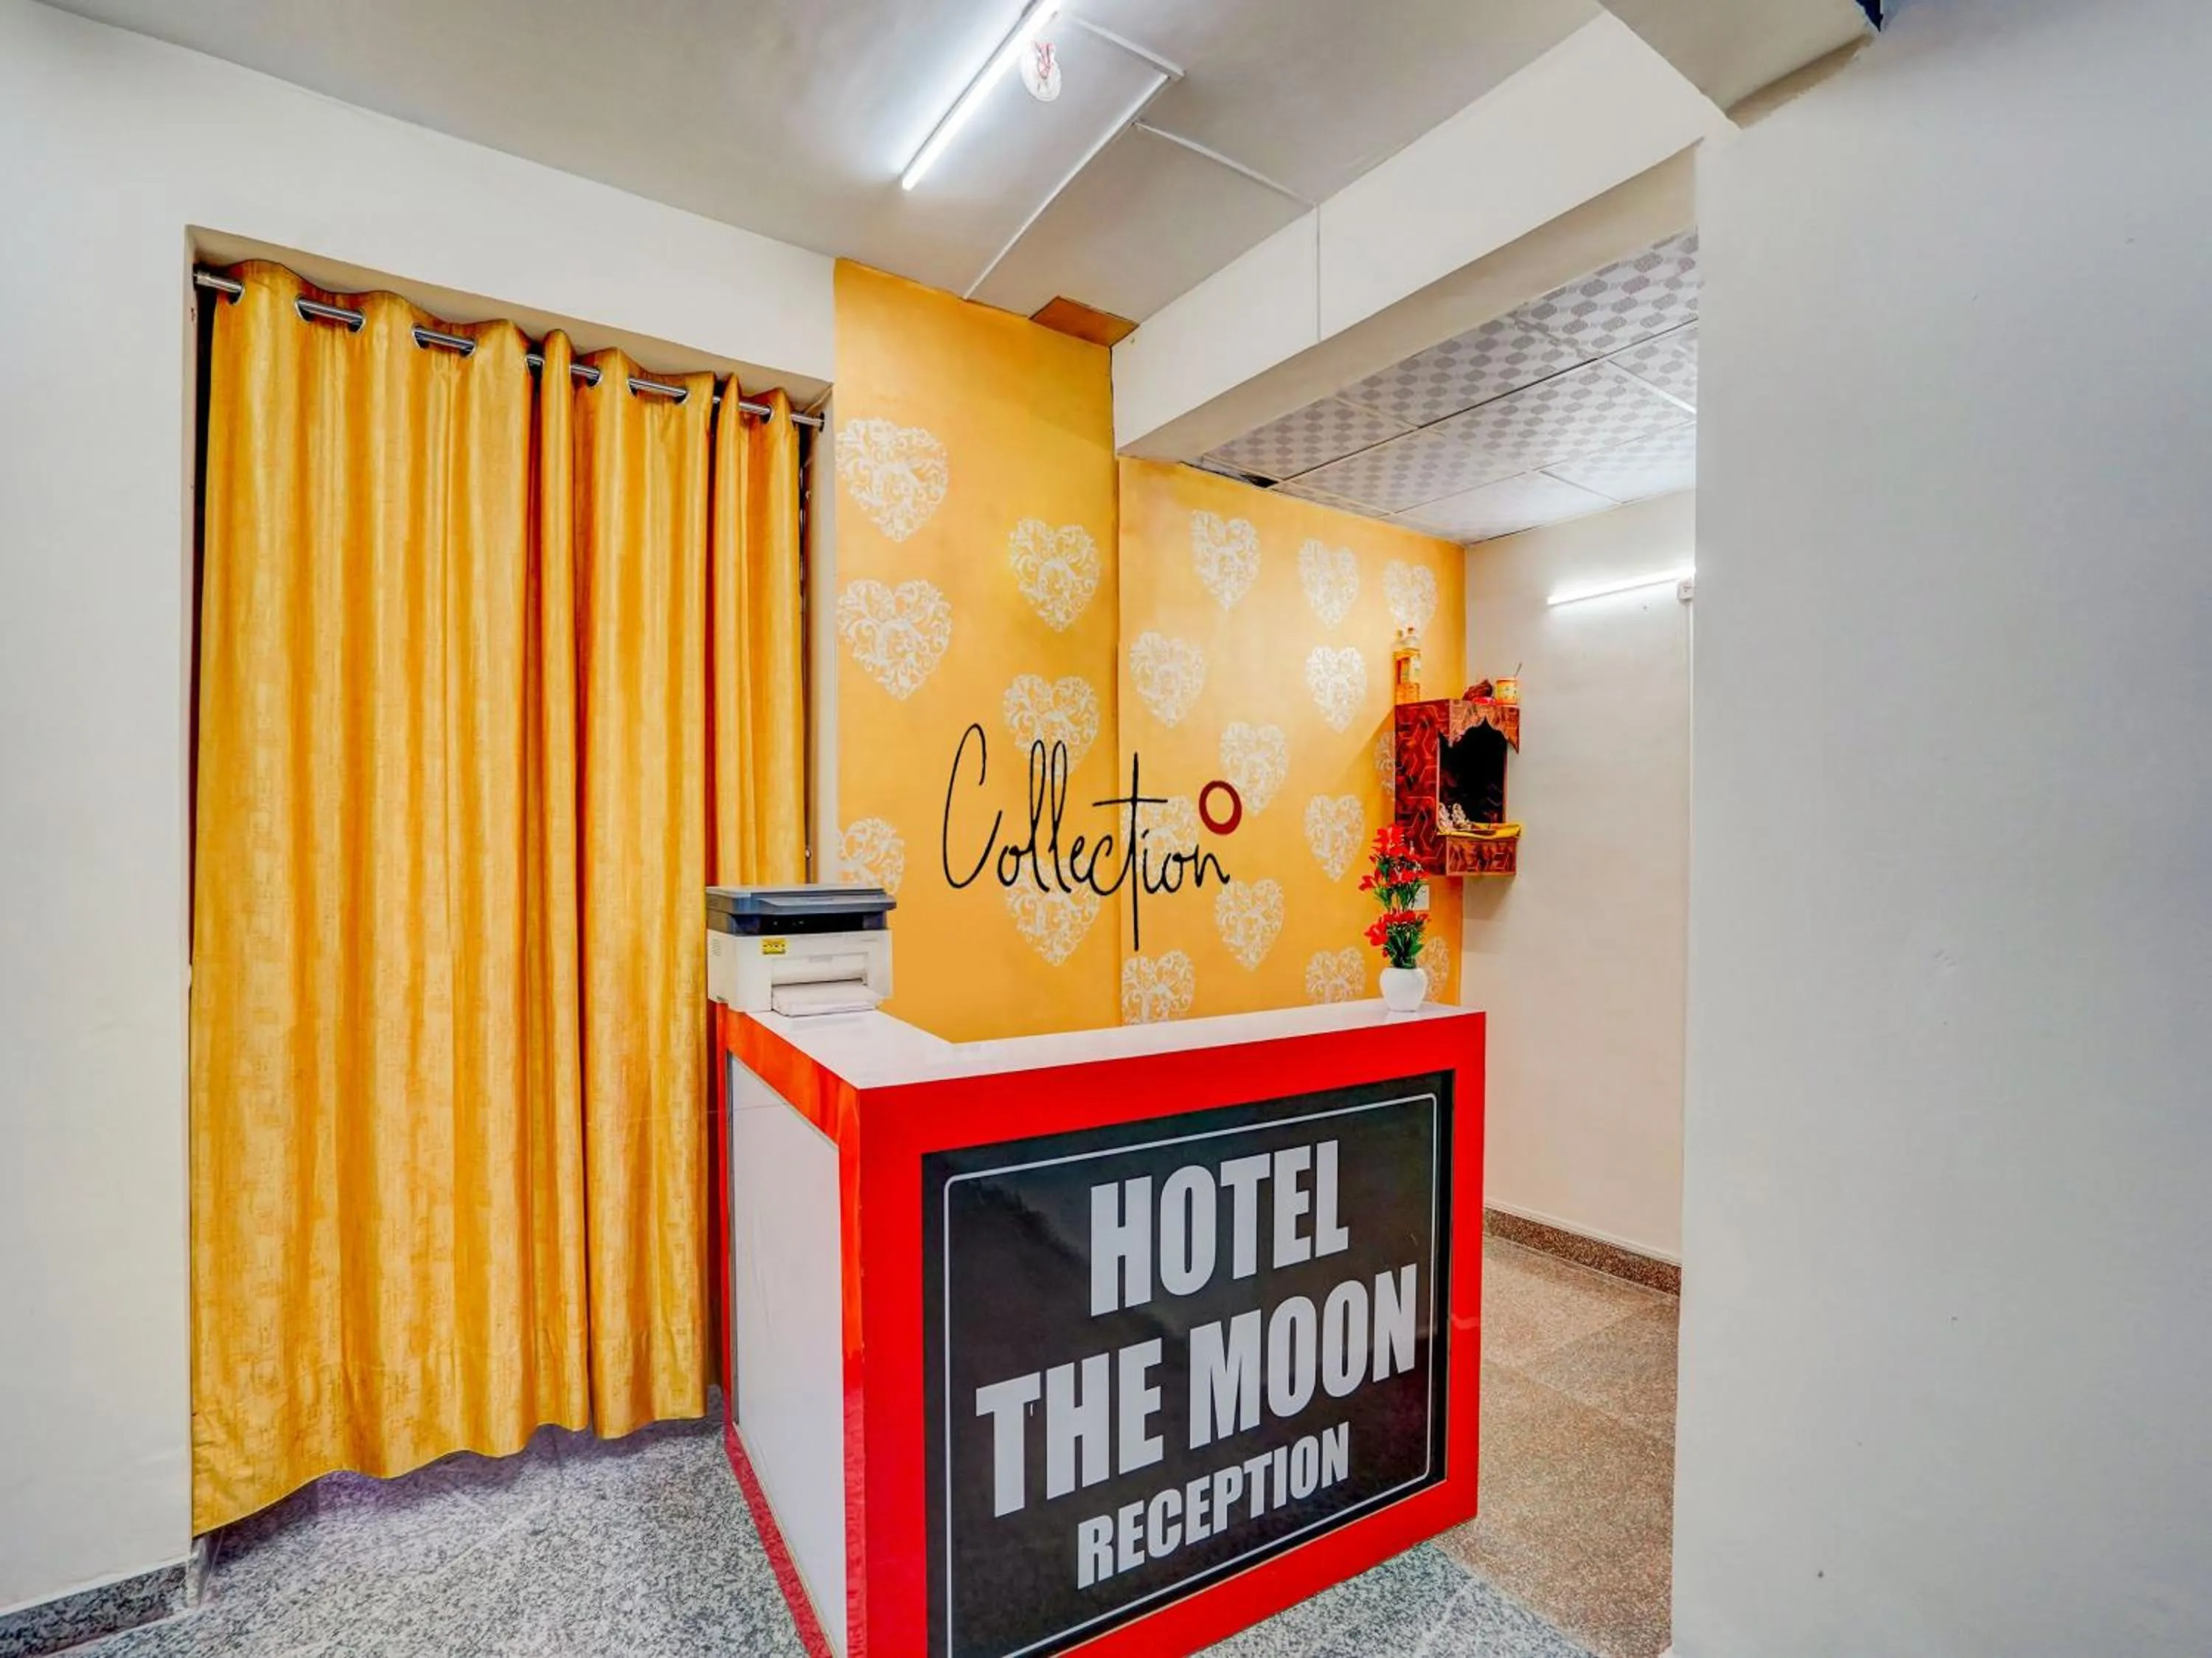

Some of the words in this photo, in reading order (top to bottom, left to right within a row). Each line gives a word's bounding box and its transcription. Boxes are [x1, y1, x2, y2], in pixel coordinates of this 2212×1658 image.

[943, 724, 1231, 951] Collection
[1091, 1140, 1349, 1317] HOTEL
[975, 1337, 1164, 1519] THE
[1189, 1263, 1417, 1451] MOON
[1077, 1421, 1349, 1591] RECEPTION
